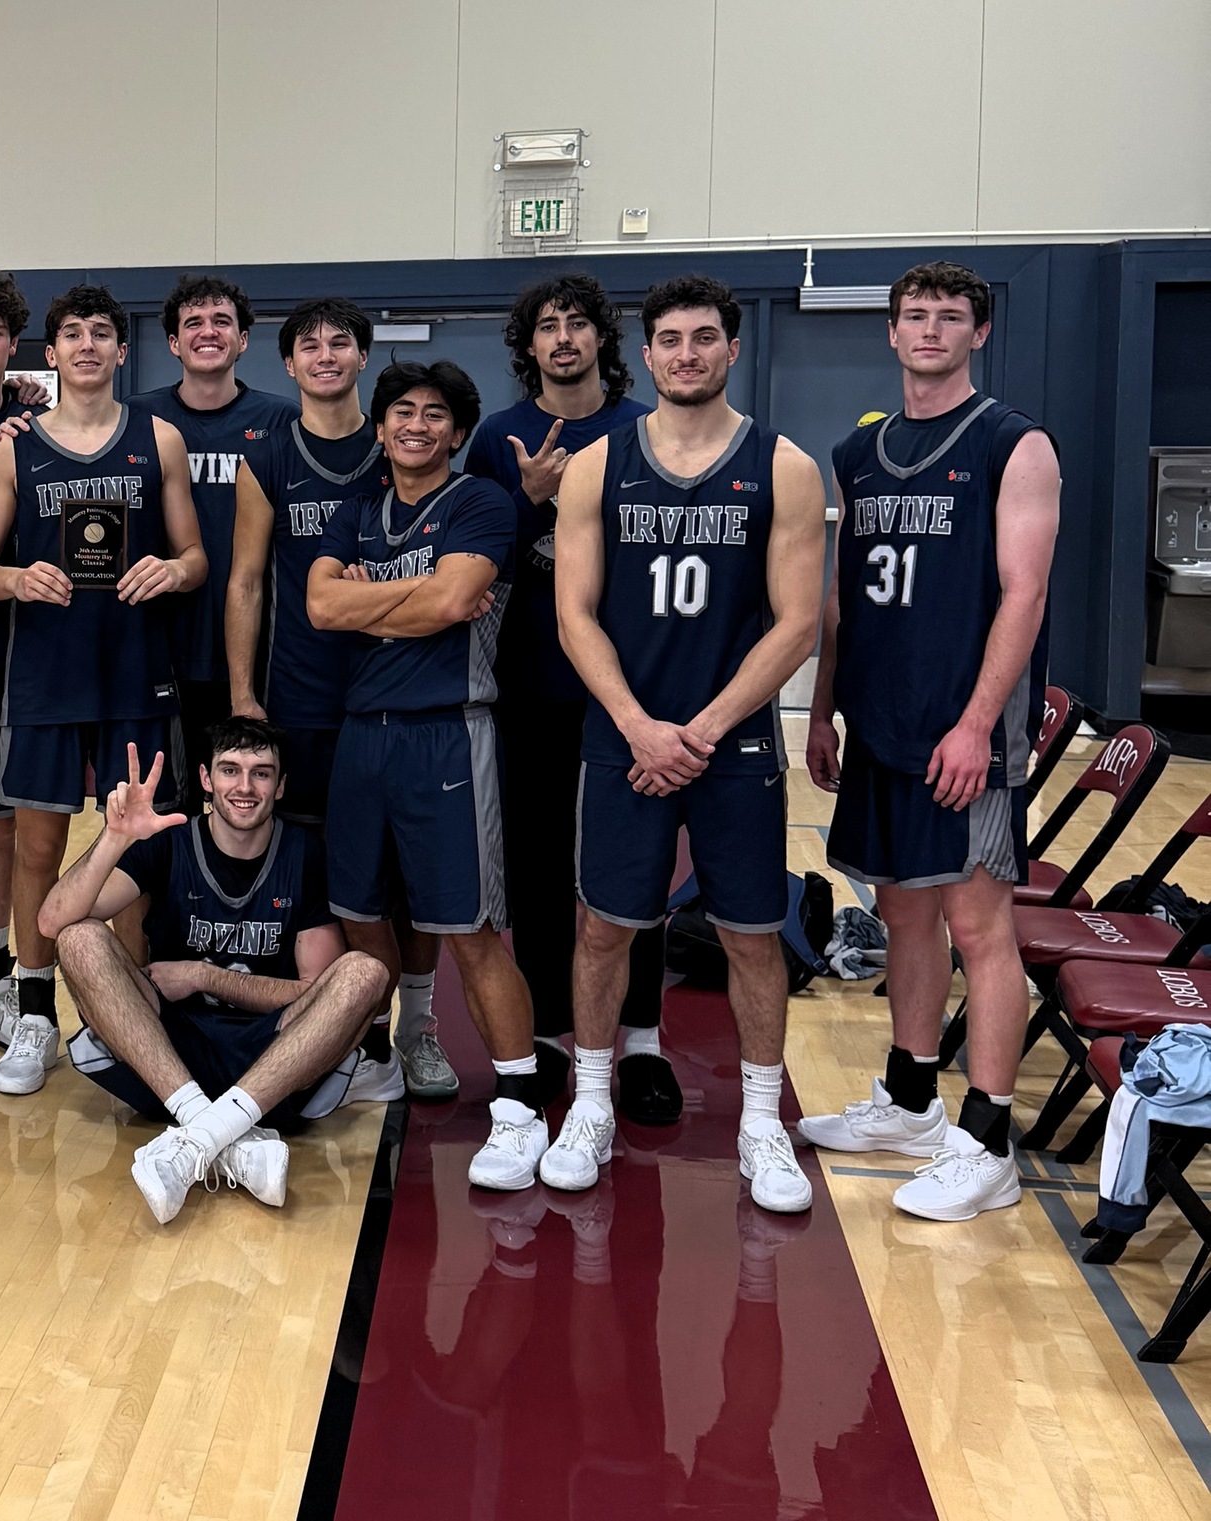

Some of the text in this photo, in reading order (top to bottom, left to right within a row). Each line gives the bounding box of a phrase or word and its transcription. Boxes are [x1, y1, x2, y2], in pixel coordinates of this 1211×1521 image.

[520, 199, 564, 233] EXIT
[188, 452, 245, 484] VIN
[36, 475, 143, 518] IRVINE
[854, 495, 955, 537] IRVINE
[618, 504, 749, 546] IRVINE
[649, 554, 710, 617] 10
[865, 544, 918, 607] 31
[1094, 738, 1139, 787] MPC
[1074, 911, 1131, 944] LOBOS
[1156, 969, 1209, 1009] LOBOS
